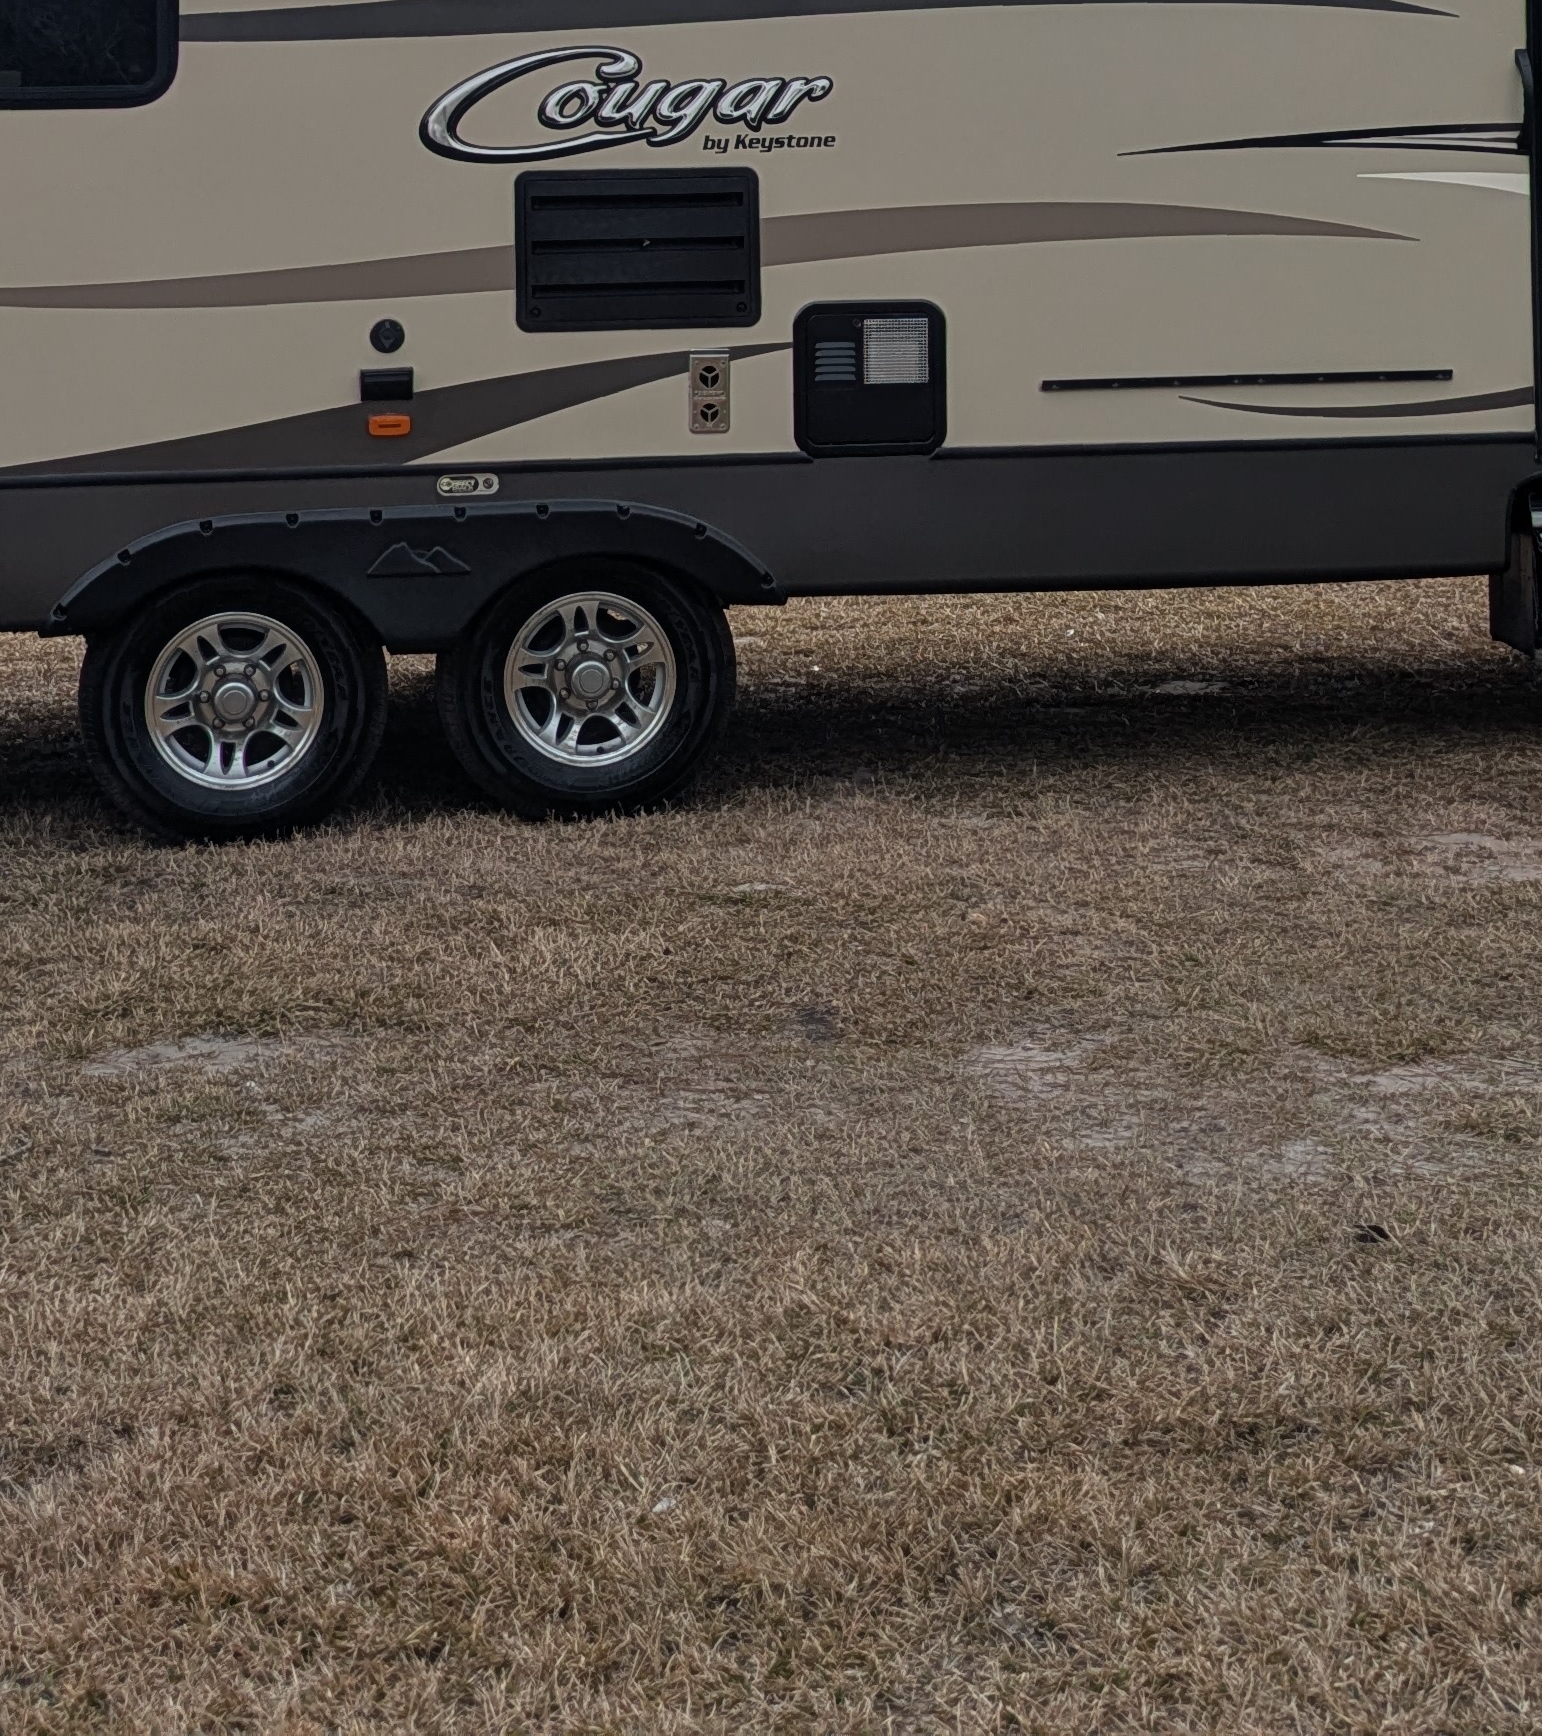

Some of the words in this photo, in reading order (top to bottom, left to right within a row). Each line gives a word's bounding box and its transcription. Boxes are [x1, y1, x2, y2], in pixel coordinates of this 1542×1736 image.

[419, 45, 833, 163] Cougar
[703, 135, 729, 153] by
[734, 133, 837, 152] Keystone
